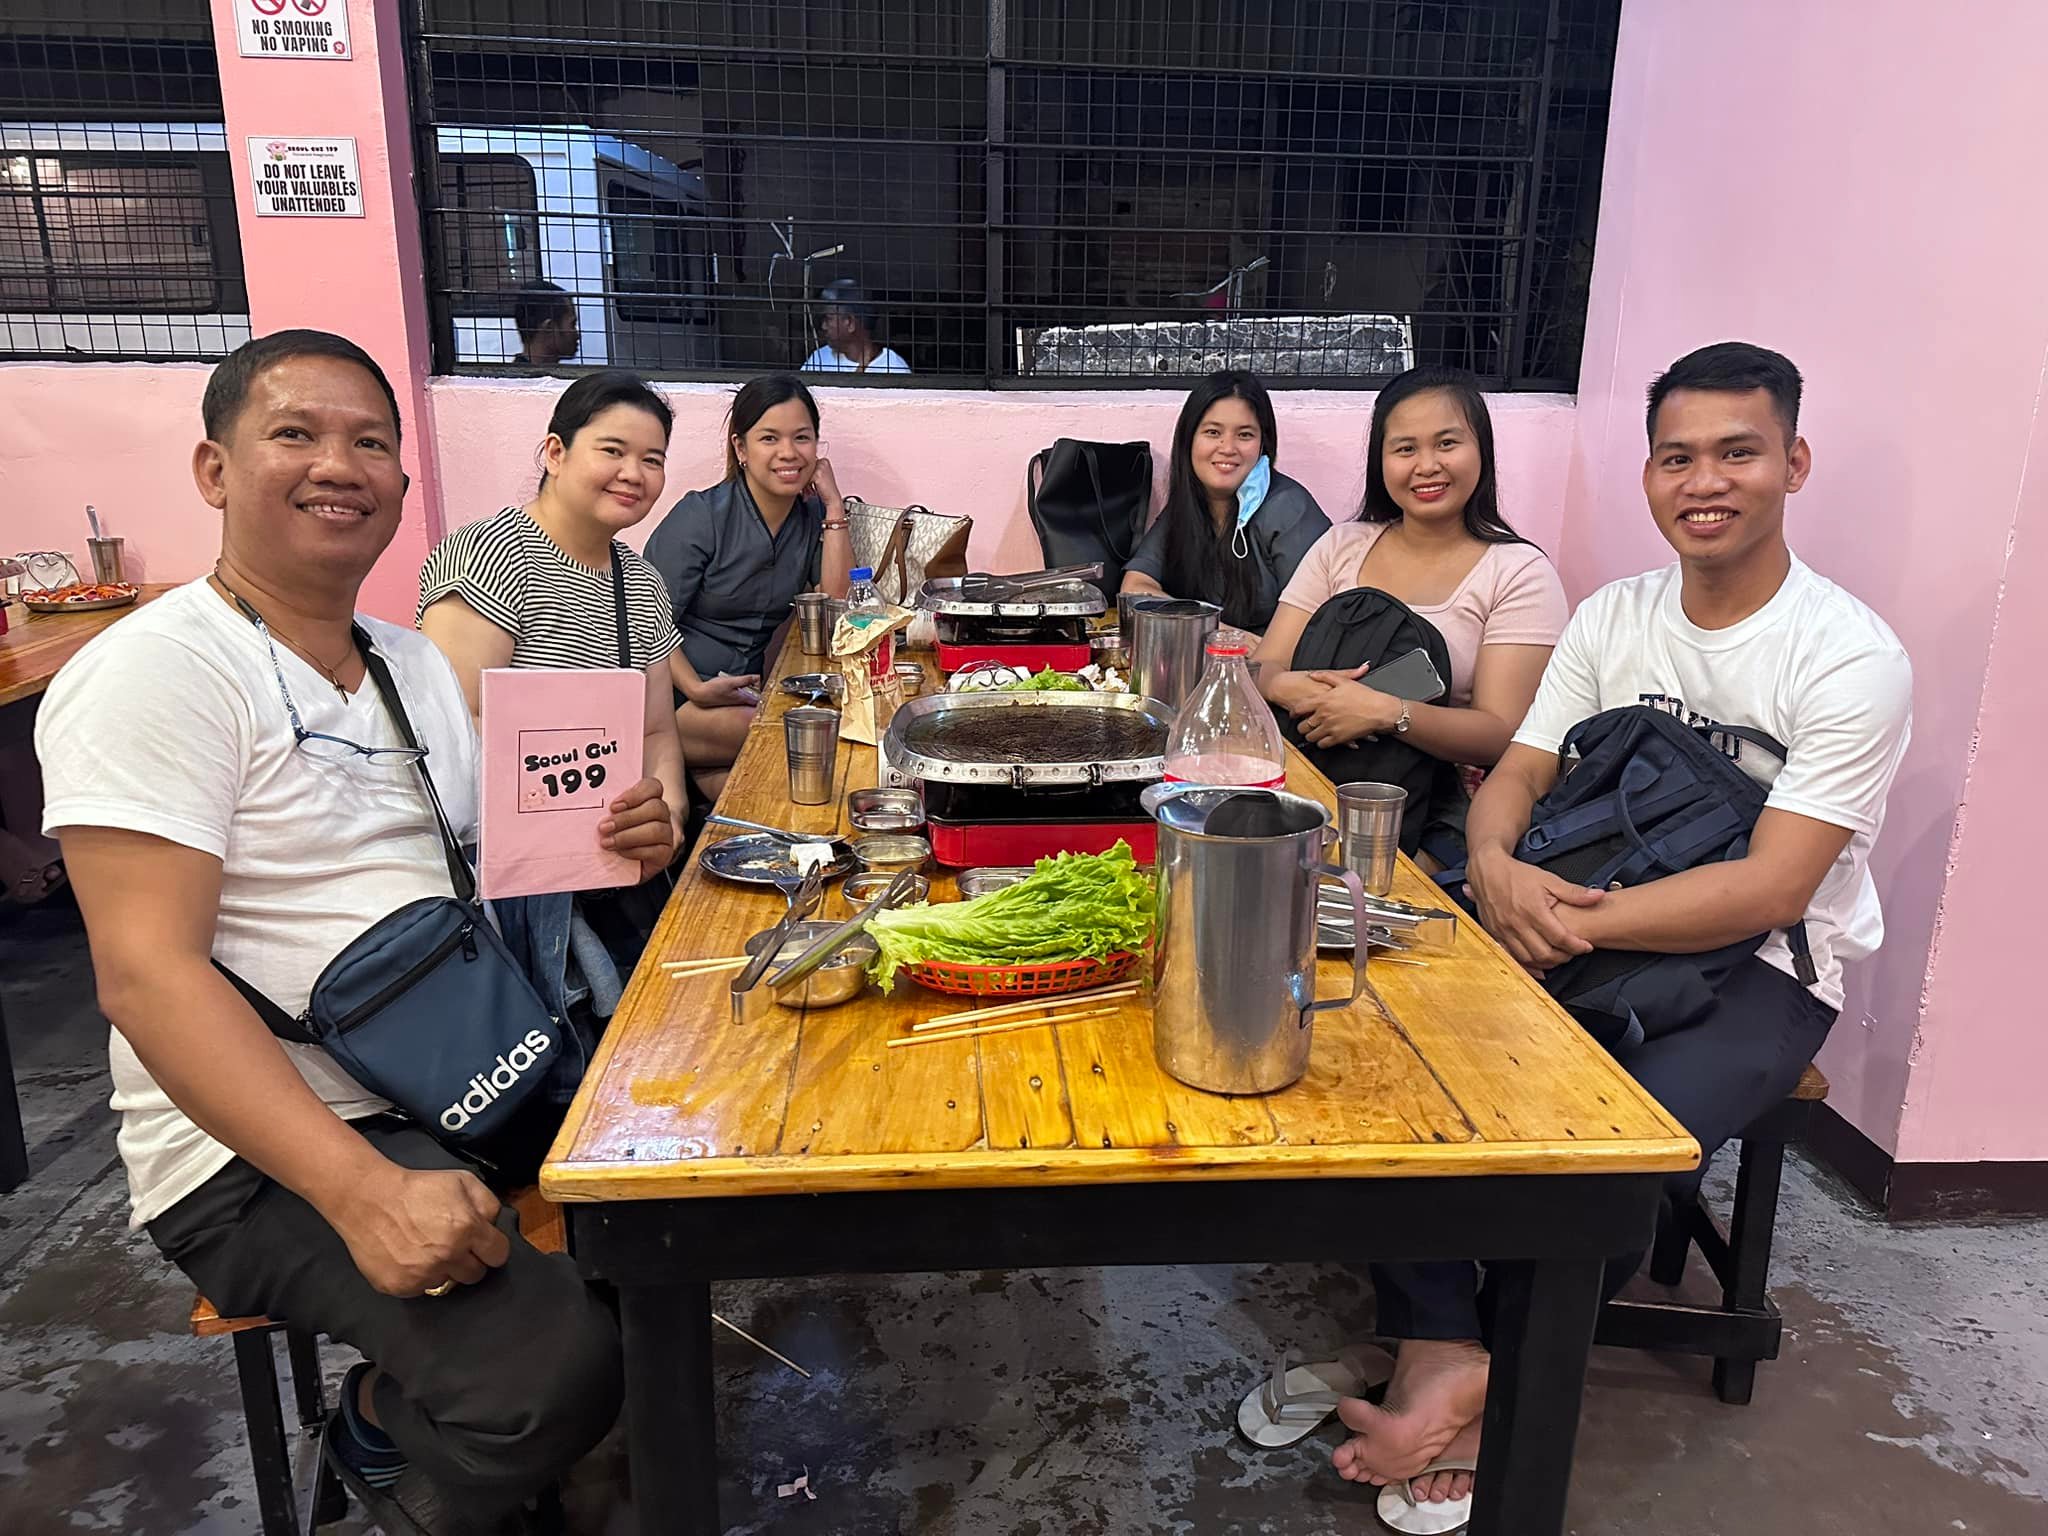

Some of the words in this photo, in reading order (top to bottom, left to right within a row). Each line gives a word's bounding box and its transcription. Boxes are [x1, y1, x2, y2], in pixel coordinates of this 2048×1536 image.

[252, 19, 269, 35] NO
[273, 20, 332, 36] SMOKING
[260, 36, 277, 51] NO
[281, 36, 328, 52] VAPING
[264, 164, 280, 179] DO
[284, 164, 306, 179] NOT
[310, 164, 346, 180] LEAVE
[256, 180, 288, 195] YOUR
[291, 181, 357, 196] VALUABLES
[272, 197, 346, 212] UNATTENDED
[524, 748, 579, 772] Seoul
[585, 740, 618, 760] Gui
[542, 764, 606, 797] 199
[440, 1029, 550, 1131] adidas
